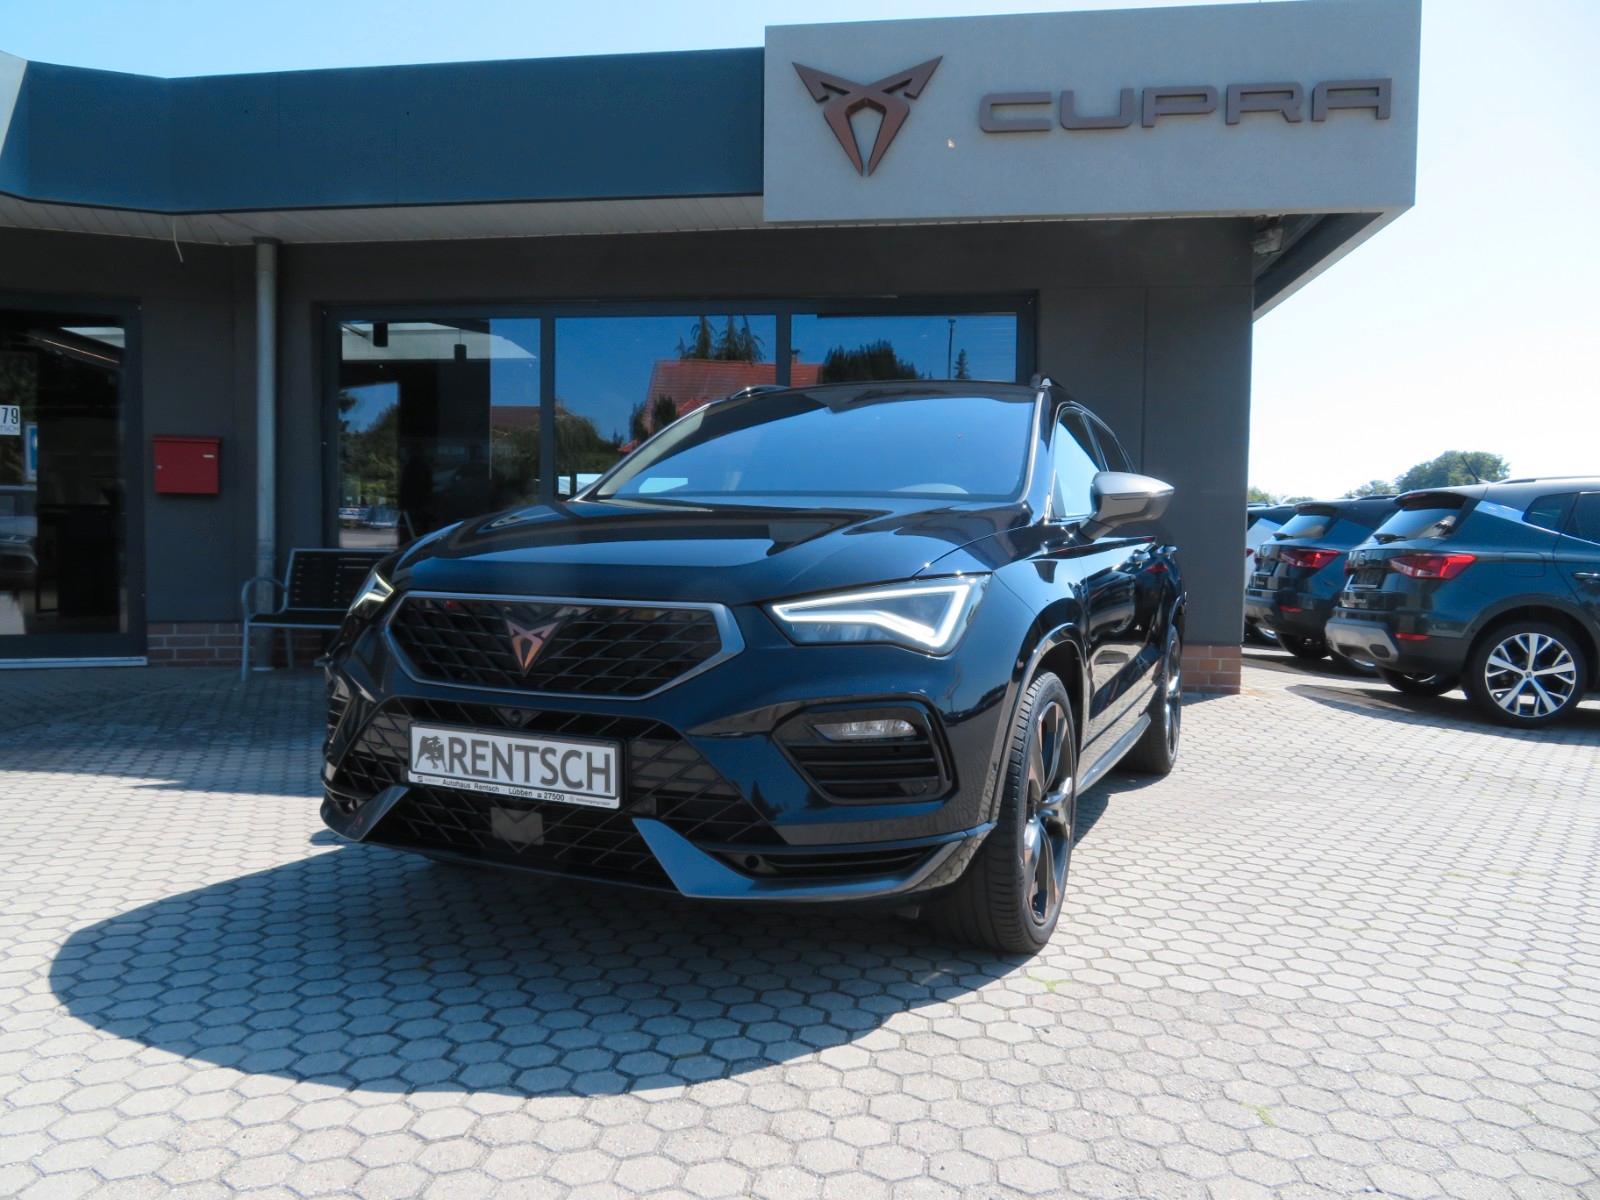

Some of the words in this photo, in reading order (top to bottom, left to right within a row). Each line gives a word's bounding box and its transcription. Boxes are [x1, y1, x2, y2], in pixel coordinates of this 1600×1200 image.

[979, 78, 1392, 133] CUPRA
[442, 778, 471, 789] Autohaus
[474, 782, 500, 793] Rentsch
[508, 787, 533, 797] Lübben
[448, 736, 612, 794] RENTSCH
